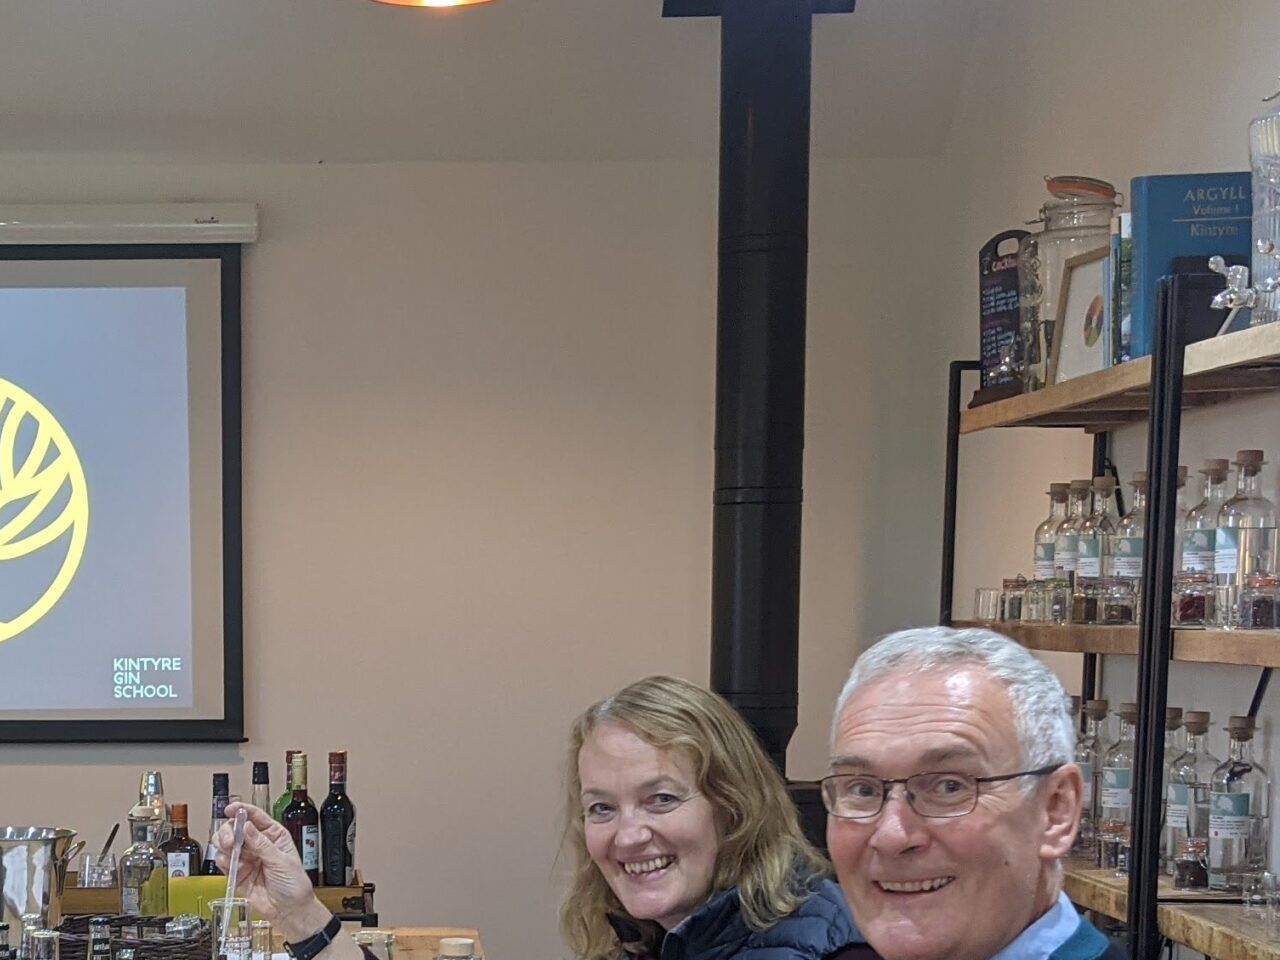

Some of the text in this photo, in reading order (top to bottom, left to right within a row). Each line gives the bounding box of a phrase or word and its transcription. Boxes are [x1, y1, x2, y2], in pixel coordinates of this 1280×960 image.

[1184, 186, 1247, 201] ARGYLL
[1192, 204, 1231, 215] Volume
[113, 658, 181, 671] KINTYRE
[113, 671, 140, 684] GIN
[113, 684, 178, 698] SCHOOL
